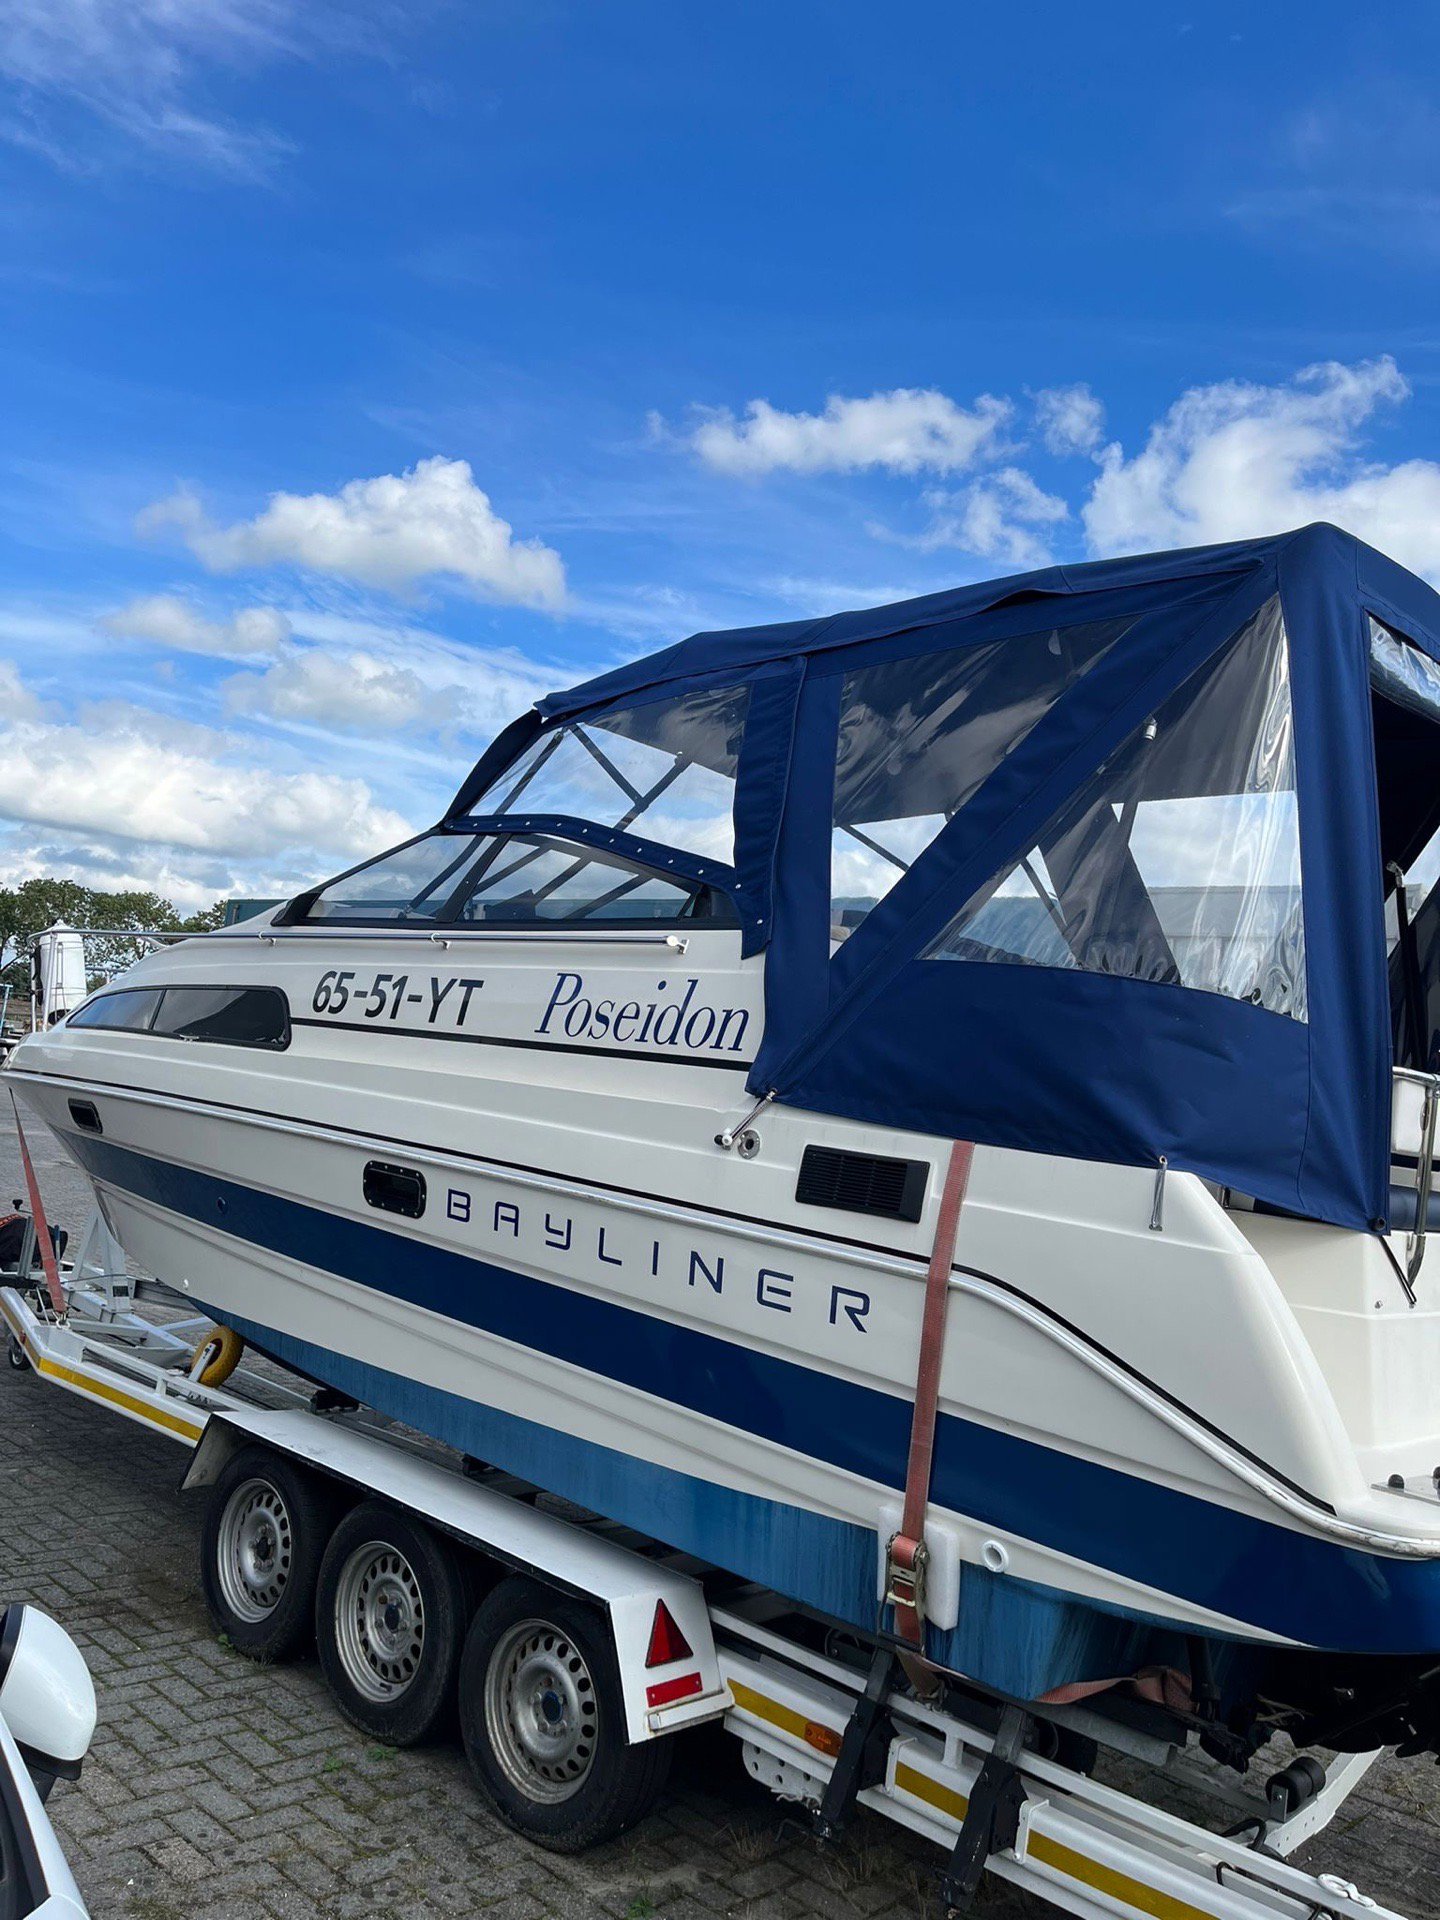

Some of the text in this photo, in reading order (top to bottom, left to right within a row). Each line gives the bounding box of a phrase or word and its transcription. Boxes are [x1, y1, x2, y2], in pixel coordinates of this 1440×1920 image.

[312, 970, 484, 1026] 65-51-YT
[534, 973, 750, 1051] Poseidon
[447, 1189, 870, 1333] BAYLINER
